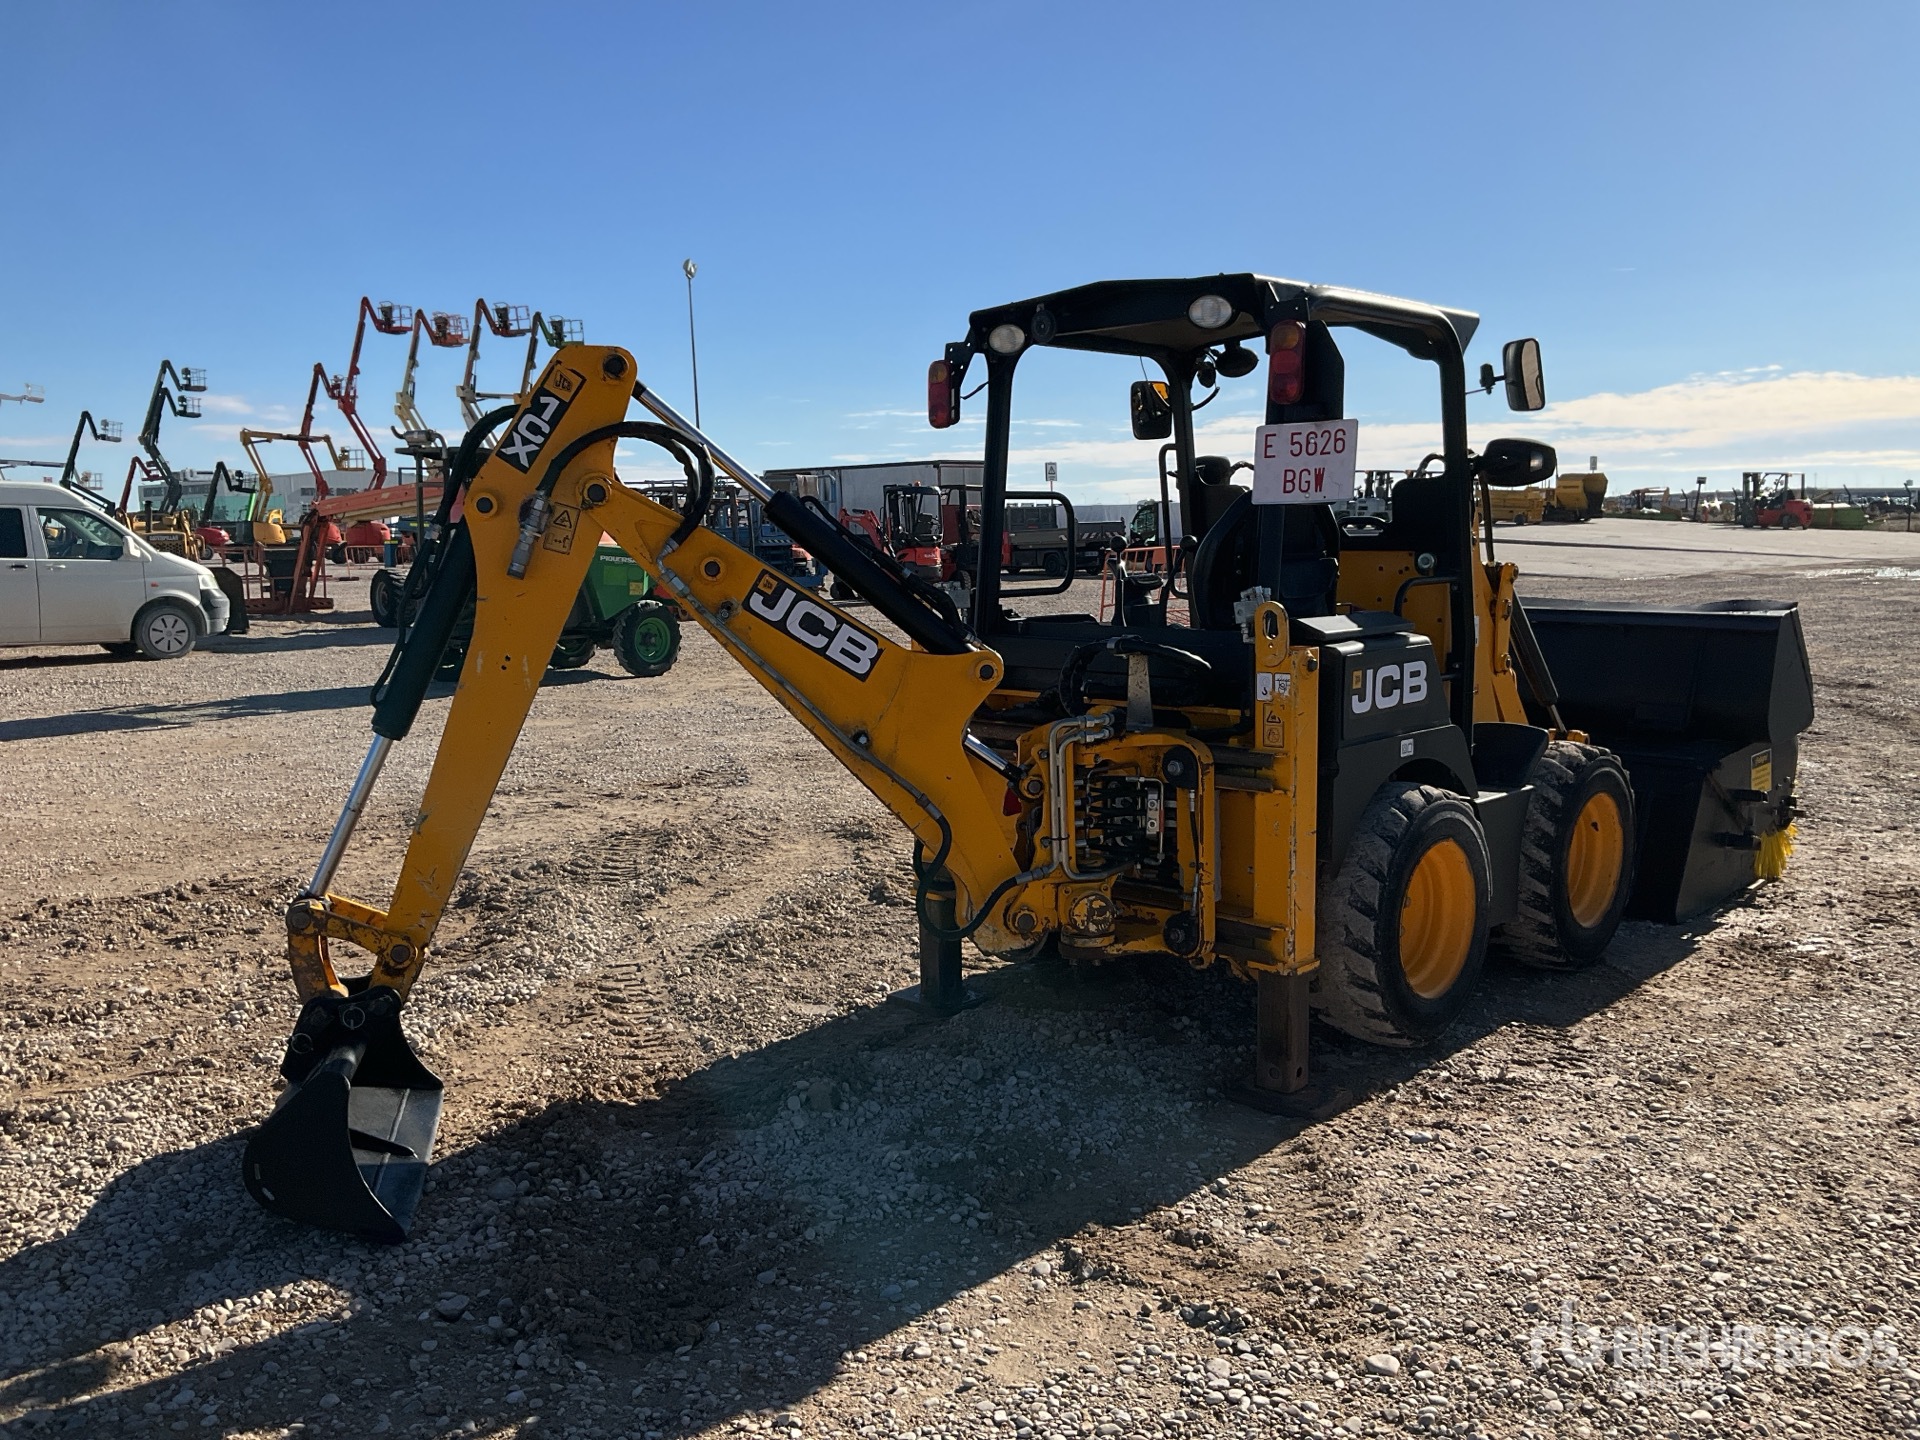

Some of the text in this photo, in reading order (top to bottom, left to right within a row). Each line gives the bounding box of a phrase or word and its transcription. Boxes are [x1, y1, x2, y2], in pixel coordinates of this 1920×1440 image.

[499, 396, 560, 468] 1CX
[1264, 428, 1346, 458] E 5626
[1282, 467, 1325, 493] BGW
[749, 587, 879, 674] JCB
[1351, 660, 1428, 714] JCB
